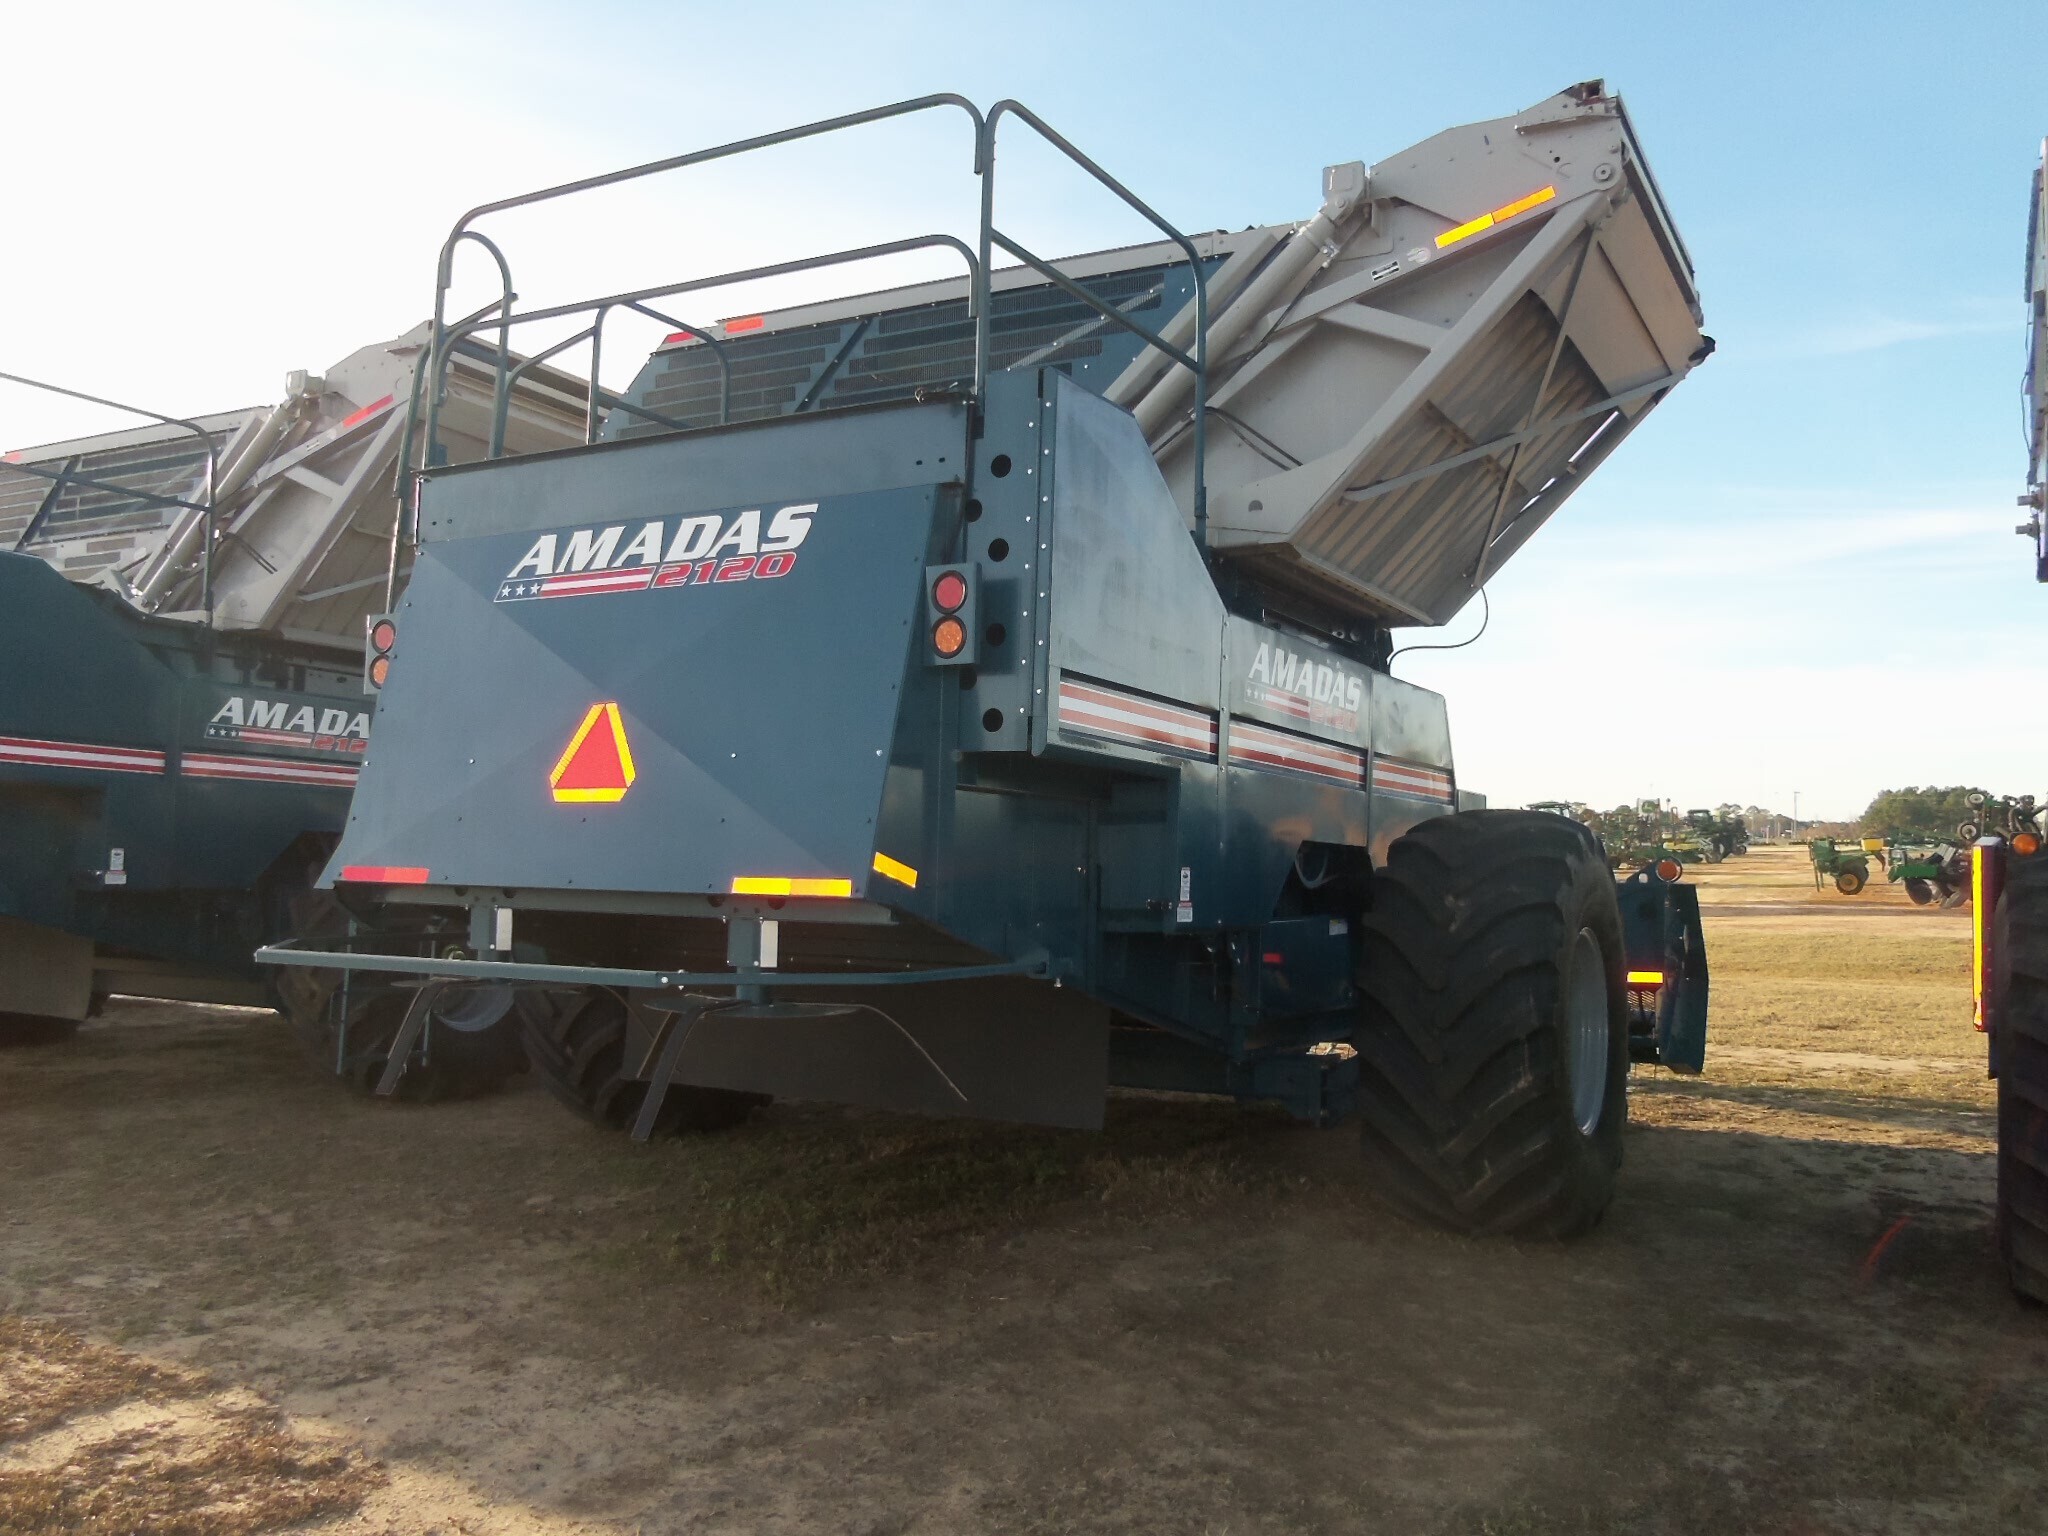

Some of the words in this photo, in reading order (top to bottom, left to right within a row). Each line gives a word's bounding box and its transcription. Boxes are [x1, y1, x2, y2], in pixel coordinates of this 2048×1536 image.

[508, 503, 818, 578] AMADAS
[651, 552, 797, 589] 2120
[1249, 643, 1362, 712] AMADAS
